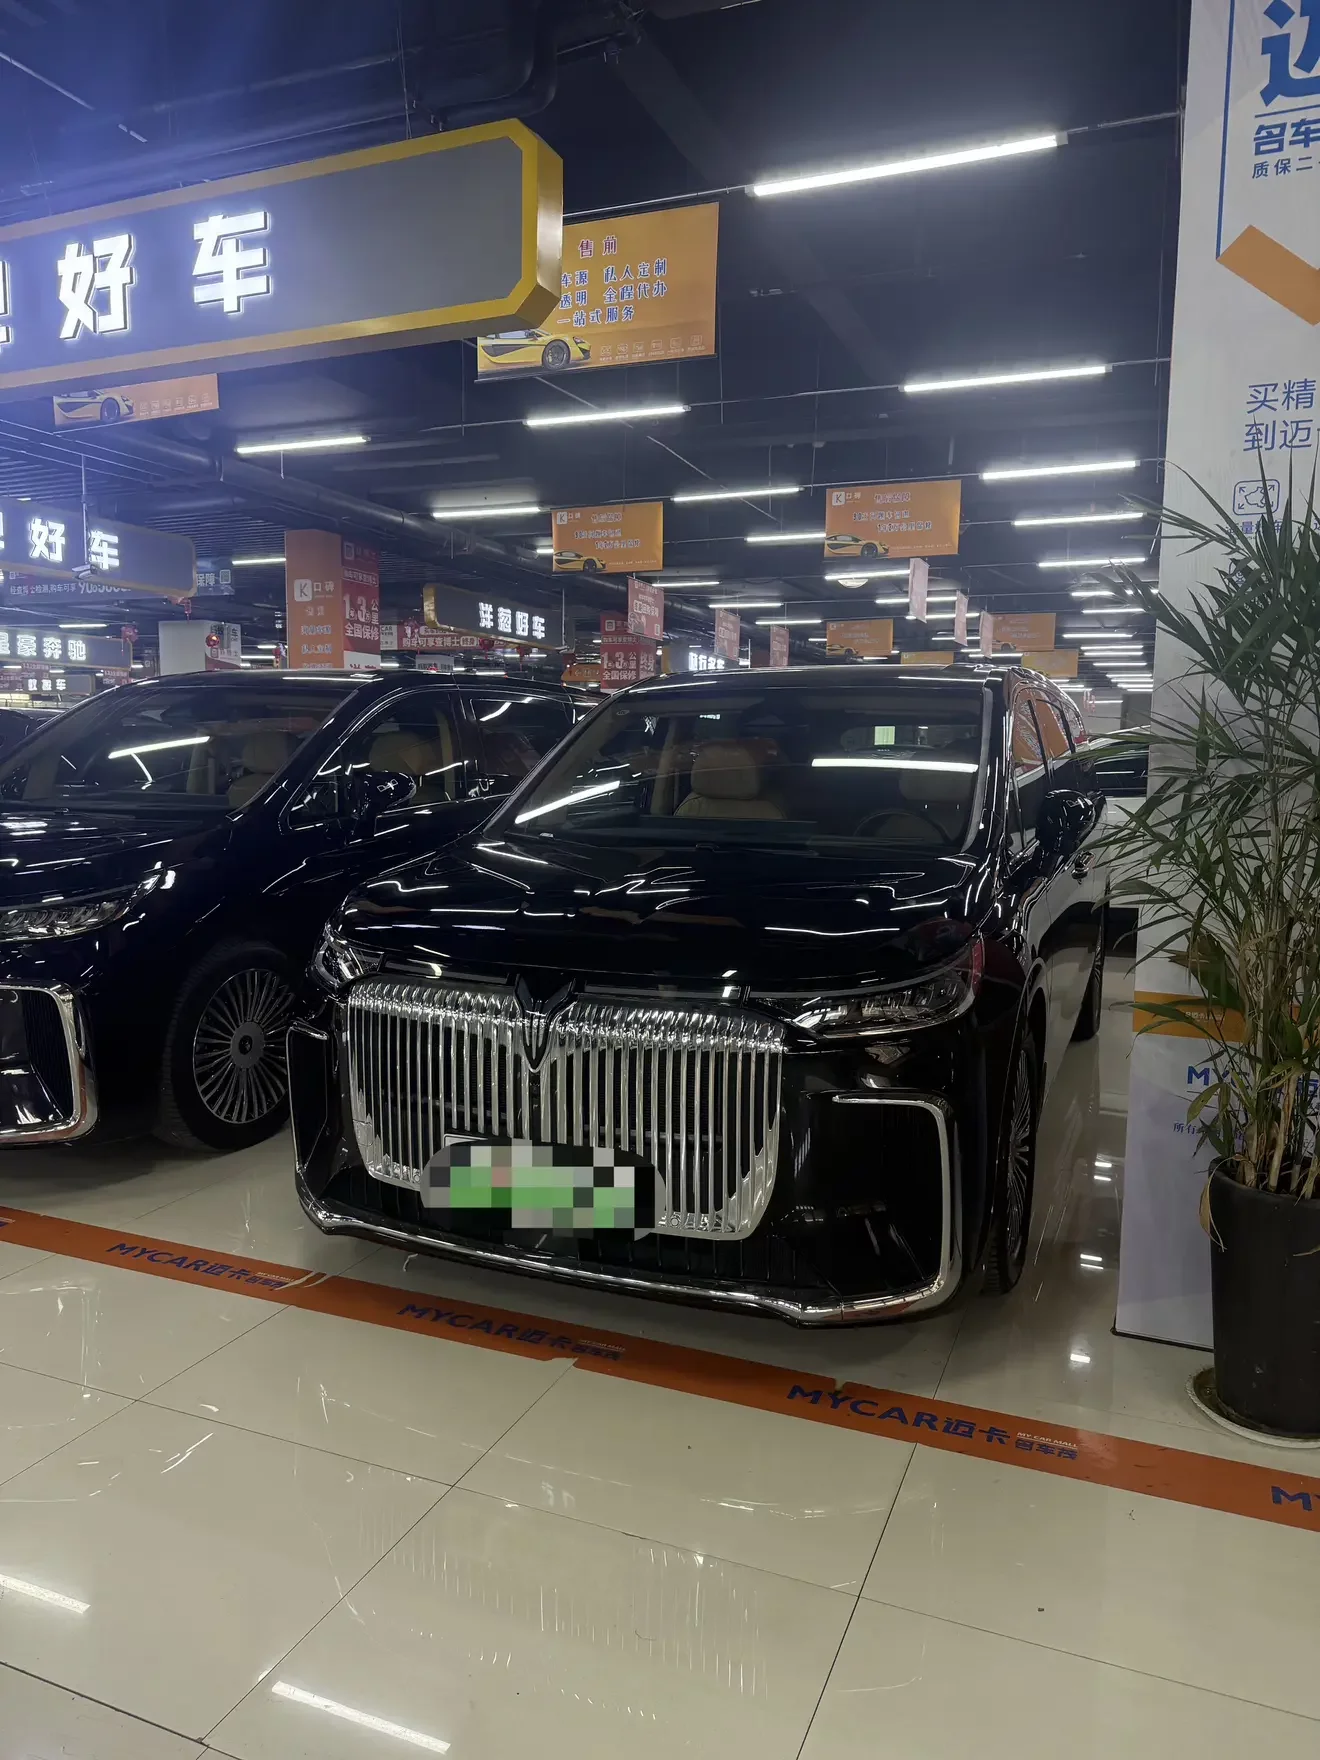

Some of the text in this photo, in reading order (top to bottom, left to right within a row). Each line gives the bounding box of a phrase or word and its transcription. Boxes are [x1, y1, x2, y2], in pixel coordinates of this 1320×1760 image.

[578, 235, 618, 258] 售前
[603, 257, 668, 284] 私人定制
[603, 280, 668, 304] 全程代办
[556, 305, 635, 328] 一站式服务
[0, 512, 120, 571] 好车
[786, 1384, 1011, 1446] MYCAR迈卡
[1053, 1439, 1077, 1448] MALL
